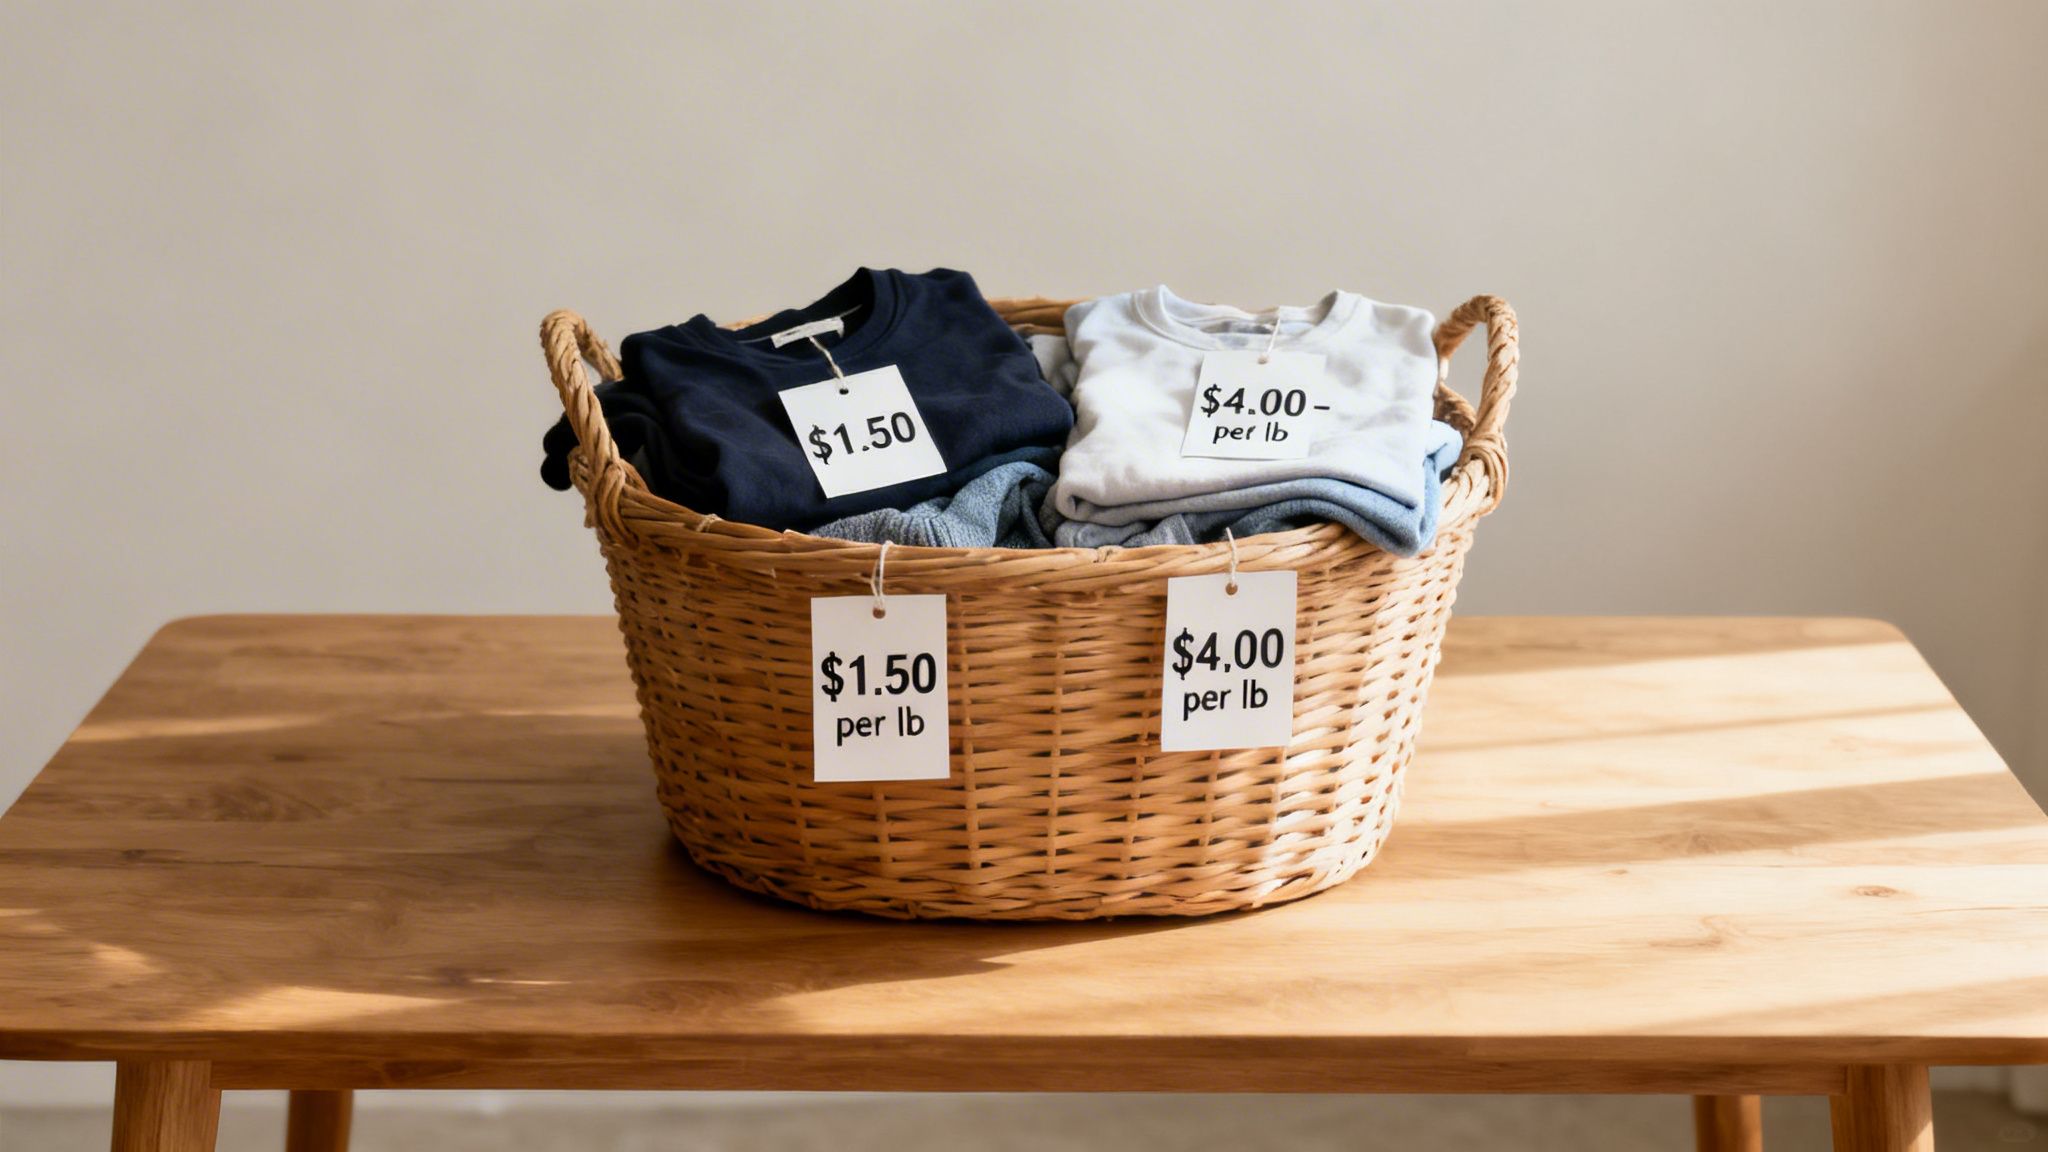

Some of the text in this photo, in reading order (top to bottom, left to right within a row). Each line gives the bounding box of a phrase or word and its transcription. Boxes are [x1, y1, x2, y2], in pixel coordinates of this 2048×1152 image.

[808, 411, 916, 465] $1.50
[1212, 421, 1289, 445] per lb
[820, 650, 937, 703] $1.50
[1182, 678, 1269, 722] per lb
[836, 705, 925, 748] per lb
